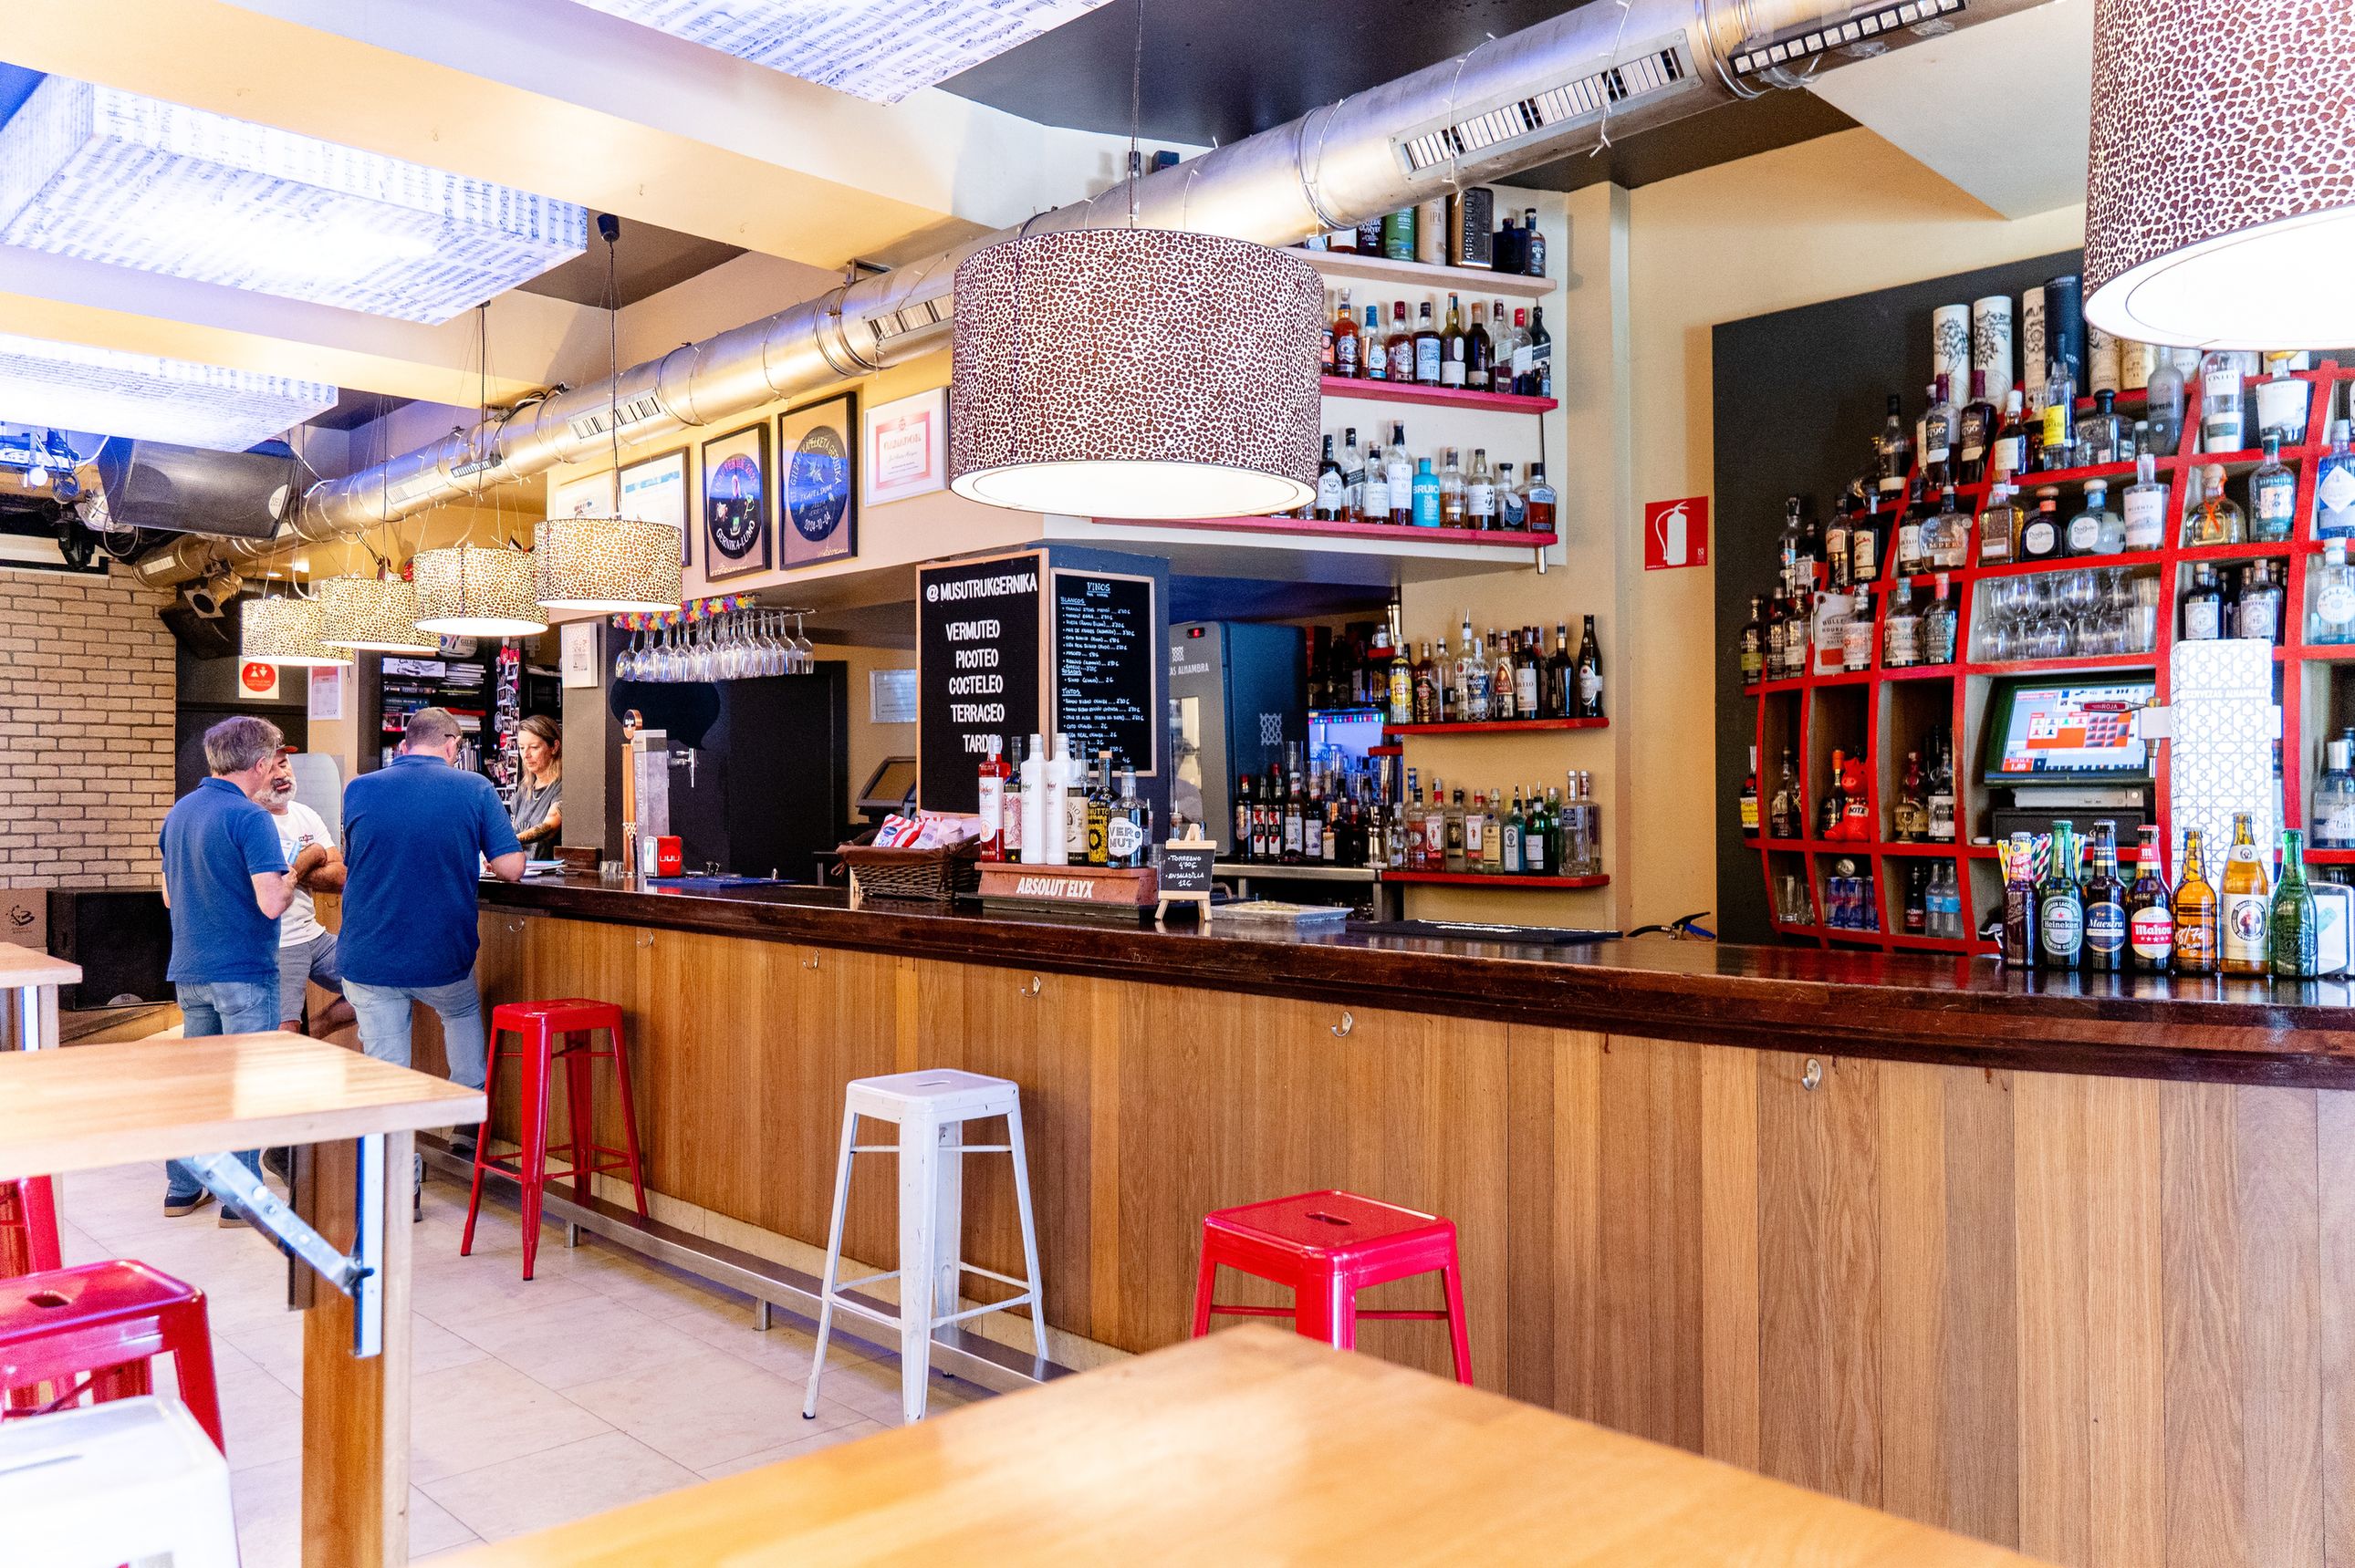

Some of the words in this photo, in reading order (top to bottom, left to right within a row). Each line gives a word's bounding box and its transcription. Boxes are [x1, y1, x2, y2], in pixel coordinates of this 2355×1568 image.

[1429, 212, 1443, 223] IPA
[926, 584, 939, 603] @
[940, 573, 1038, 600] MUSUTRUKGERNIKA
[1087, 582, 1110, 591] VINOS
[946, 619, 1000, 642] VERMUTEO
[955, 649, 999, 669] PICOTEO
[1178, 662, 1209, 675] ALHAMBRA
[949, 674, 1004, 695] COCTELEO
[950, 703, 1005, 722] TERRACEO
[963, 733, 1003, 753] TARD
[1110, 826, 1133, 836] VER
[1110, 838, 1134, 847] MUT
[1016, 877, 1066, 897] ABSOLUT
[1066, 879, 1095, 898] ELYX
[2044, 920, 2079, 929] Heineken
[2088, 919, 2123, 929] Maestra
[2134, 924, 2172, 936] Mahou
